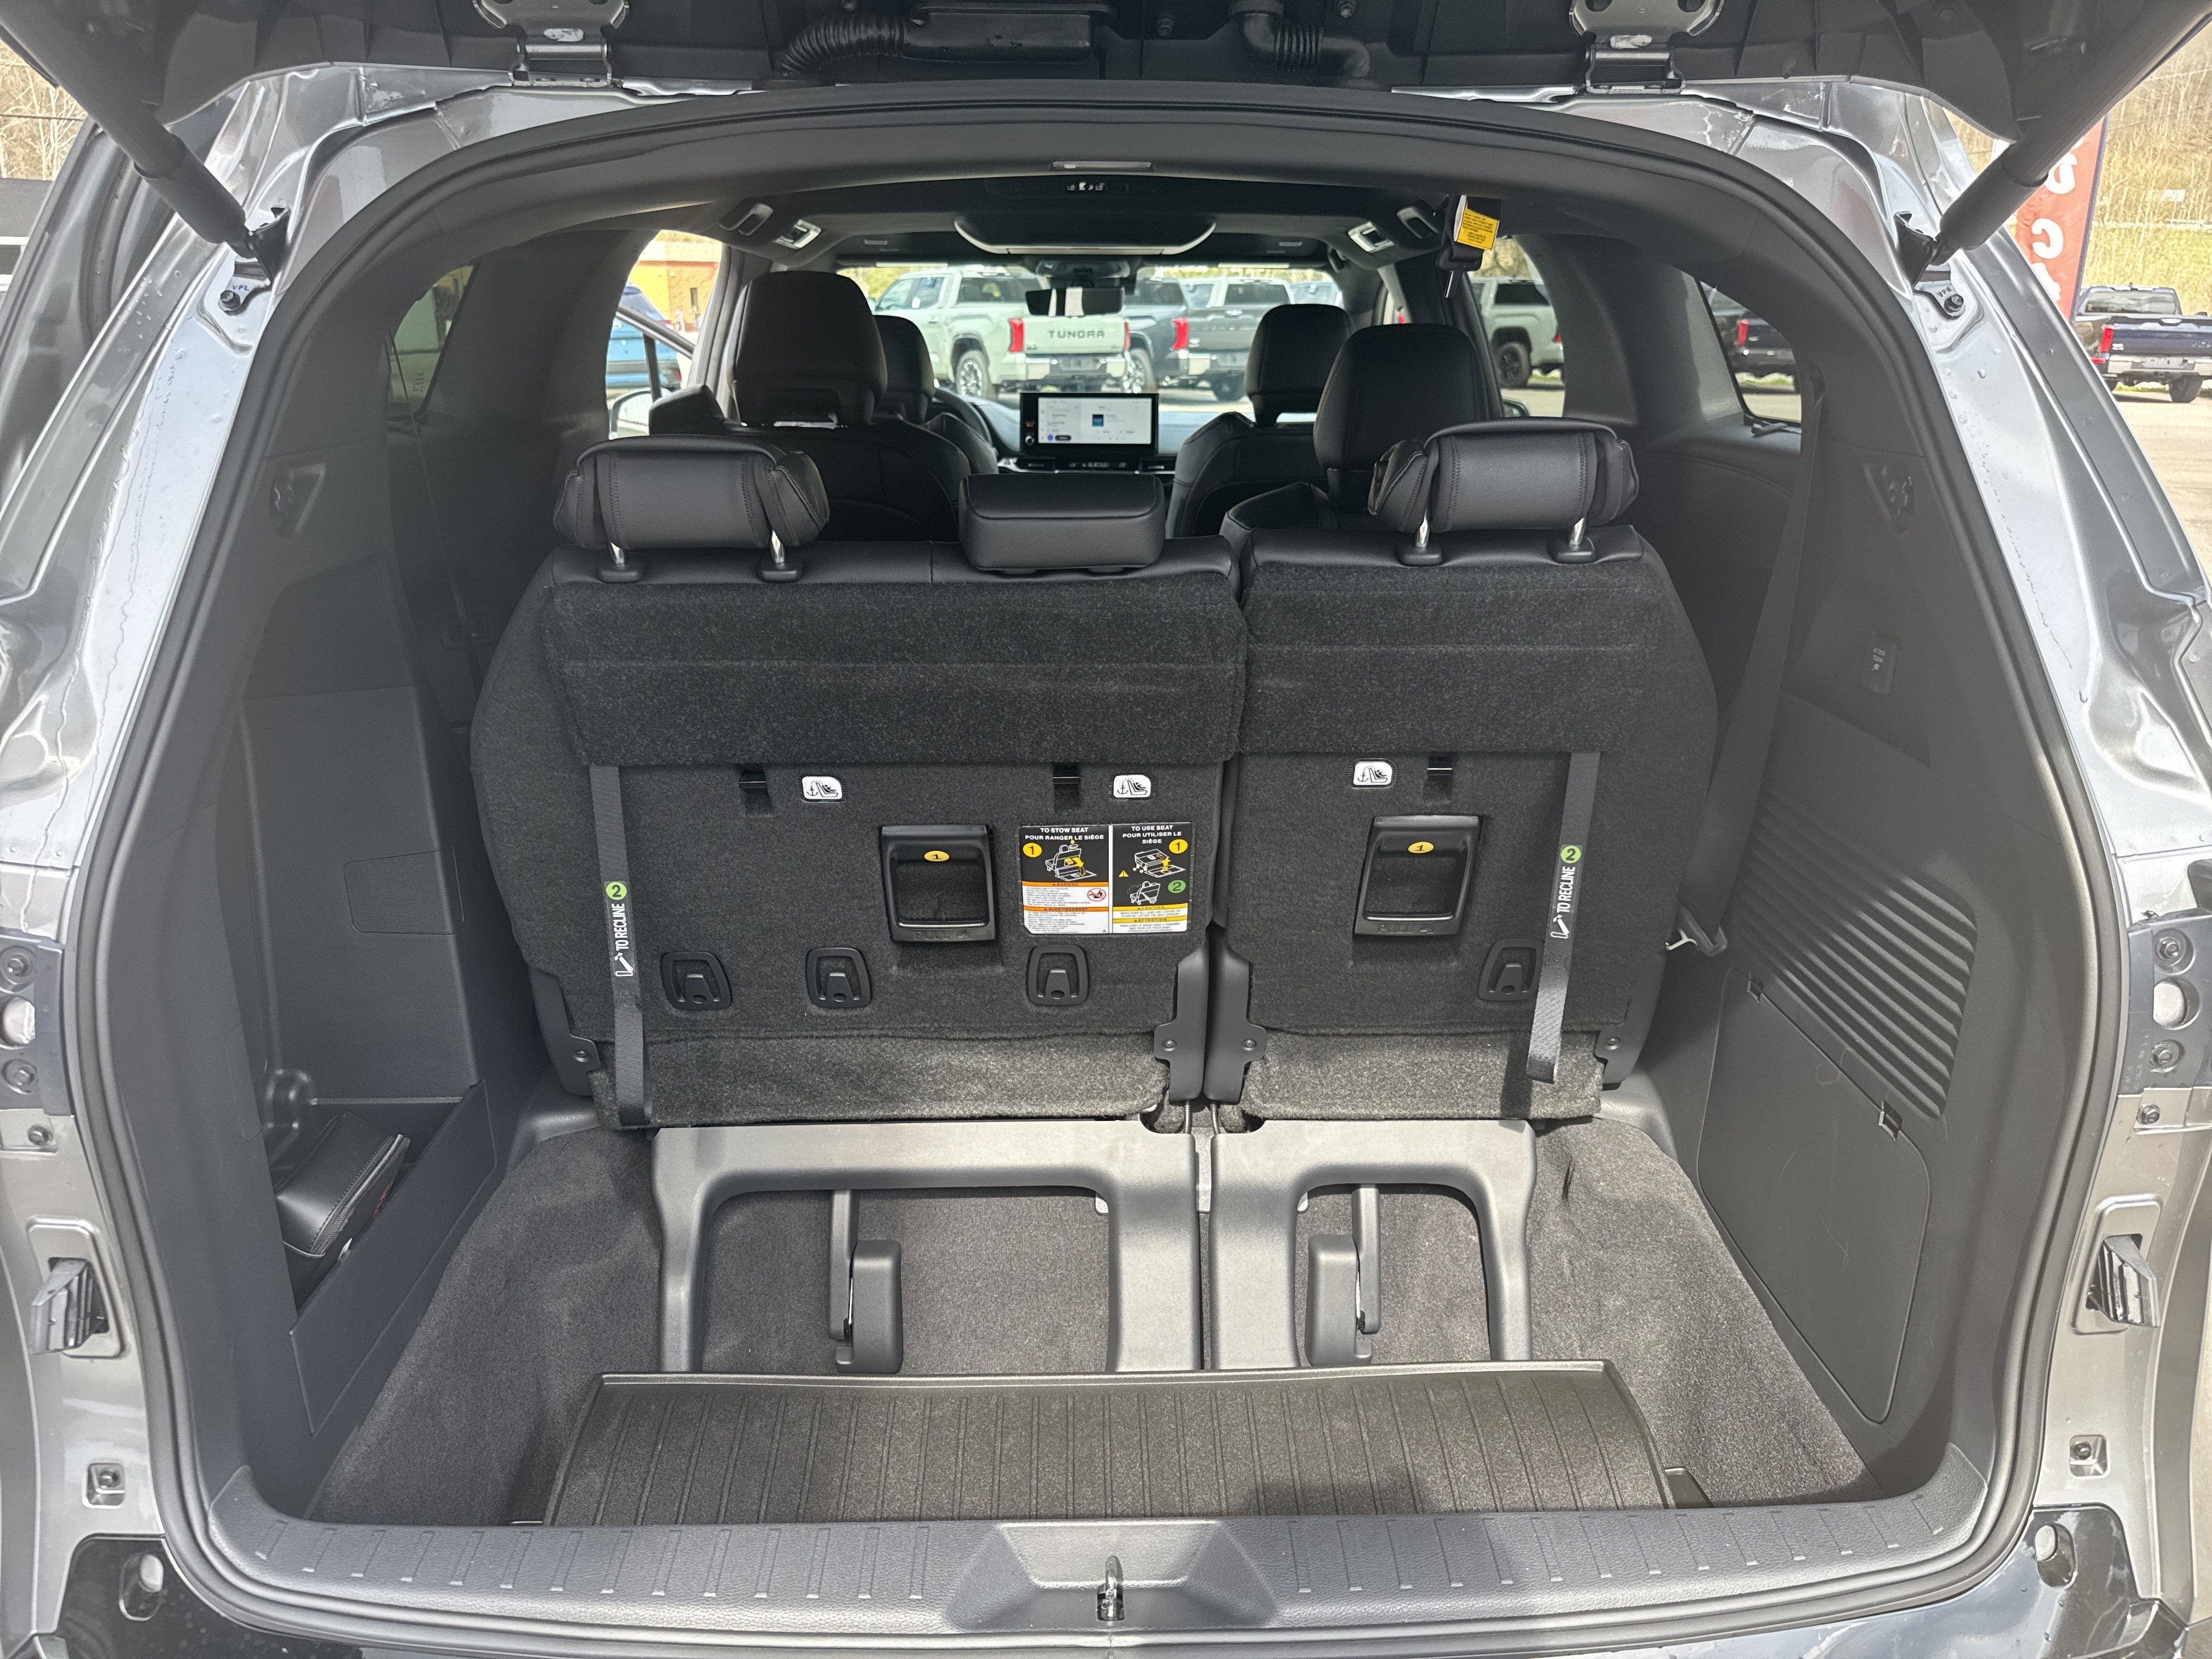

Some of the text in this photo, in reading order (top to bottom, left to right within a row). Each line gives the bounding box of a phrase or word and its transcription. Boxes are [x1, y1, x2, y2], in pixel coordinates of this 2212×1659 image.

[1048, 330, 1105, 338] TUNDRA
[1029, 845, 1034, 855] 1
[1175, 842, 1180, 851] 1
[1566, 848, 1576, 861] 2
[611, 884, 622, 898] 2
[1172, 882, 1181, 891] 2
[1557, 866, 1576, 913] TO RECLINE
[612, 904, 629, 951] TO RECLINE
